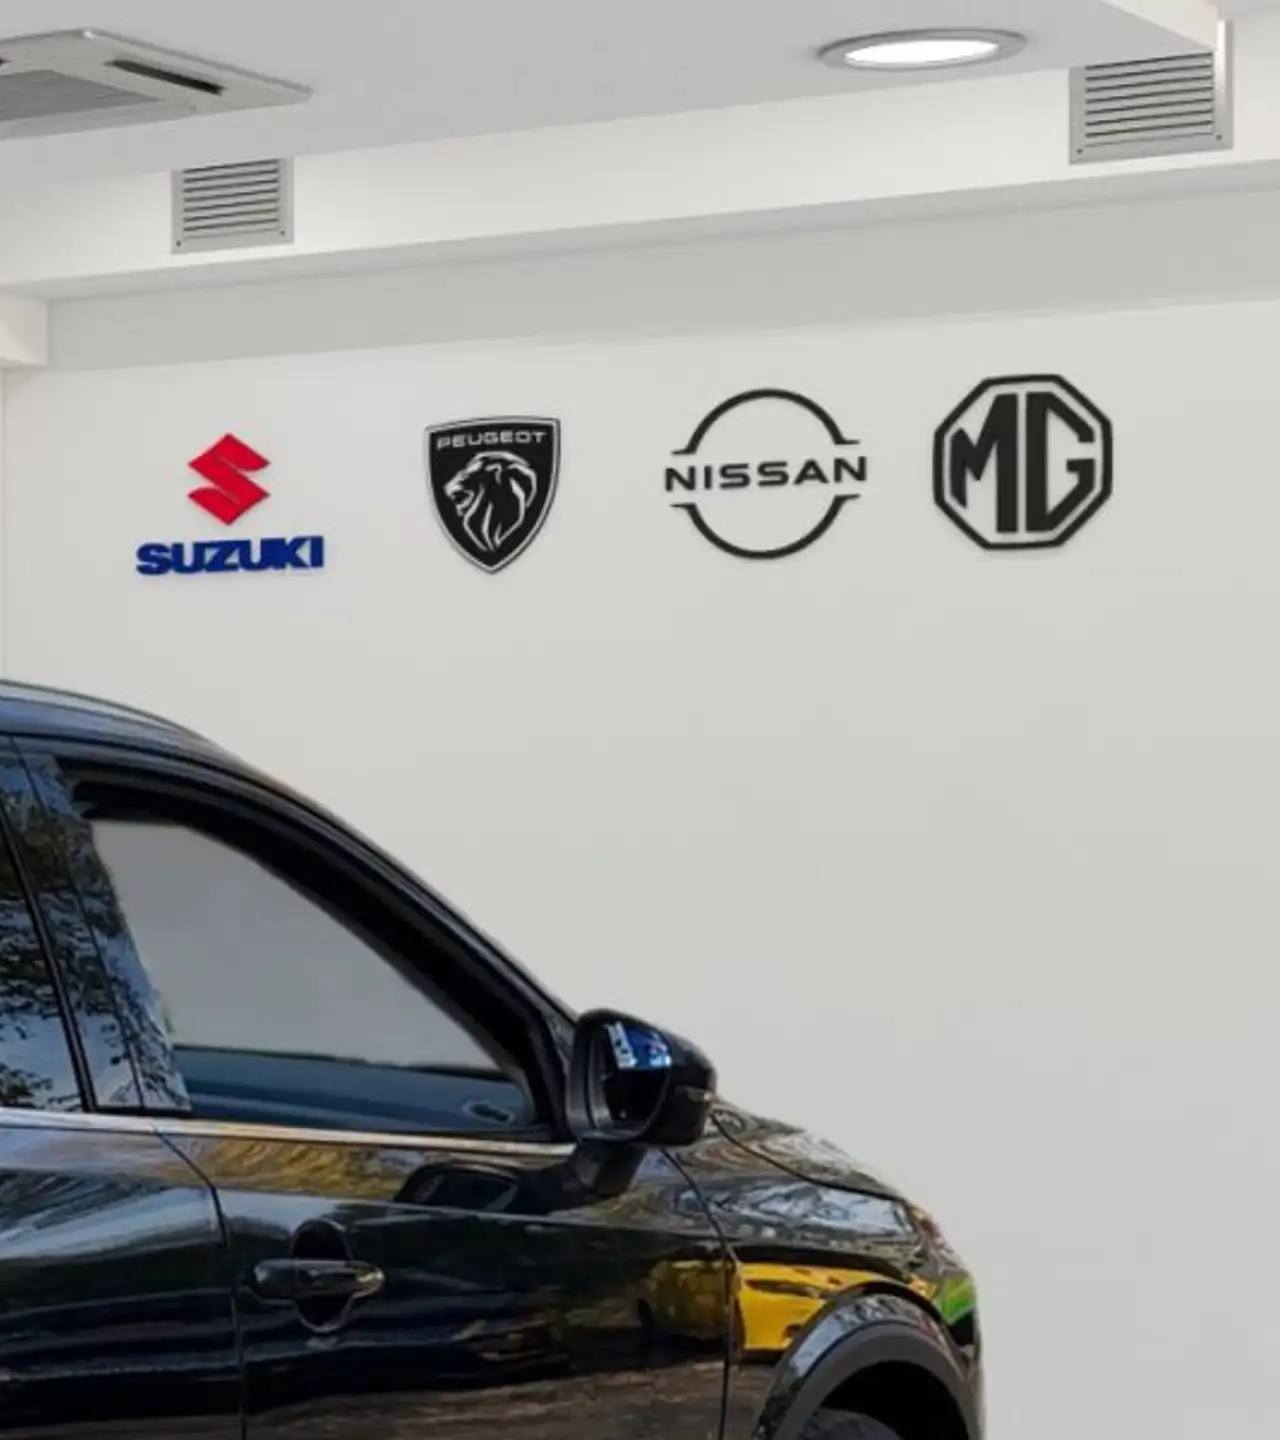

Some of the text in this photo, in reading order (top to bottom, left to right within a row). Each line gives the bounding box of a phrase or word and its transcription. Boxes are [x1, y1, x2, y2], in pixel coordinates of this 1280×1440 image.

[436, 429, 549, 450] PEUGEOT
[664, 455, 867, 492] NISSAN
[949, 391, 1096, 533] MG
[136, 535, 325, 576] SUZUKI
